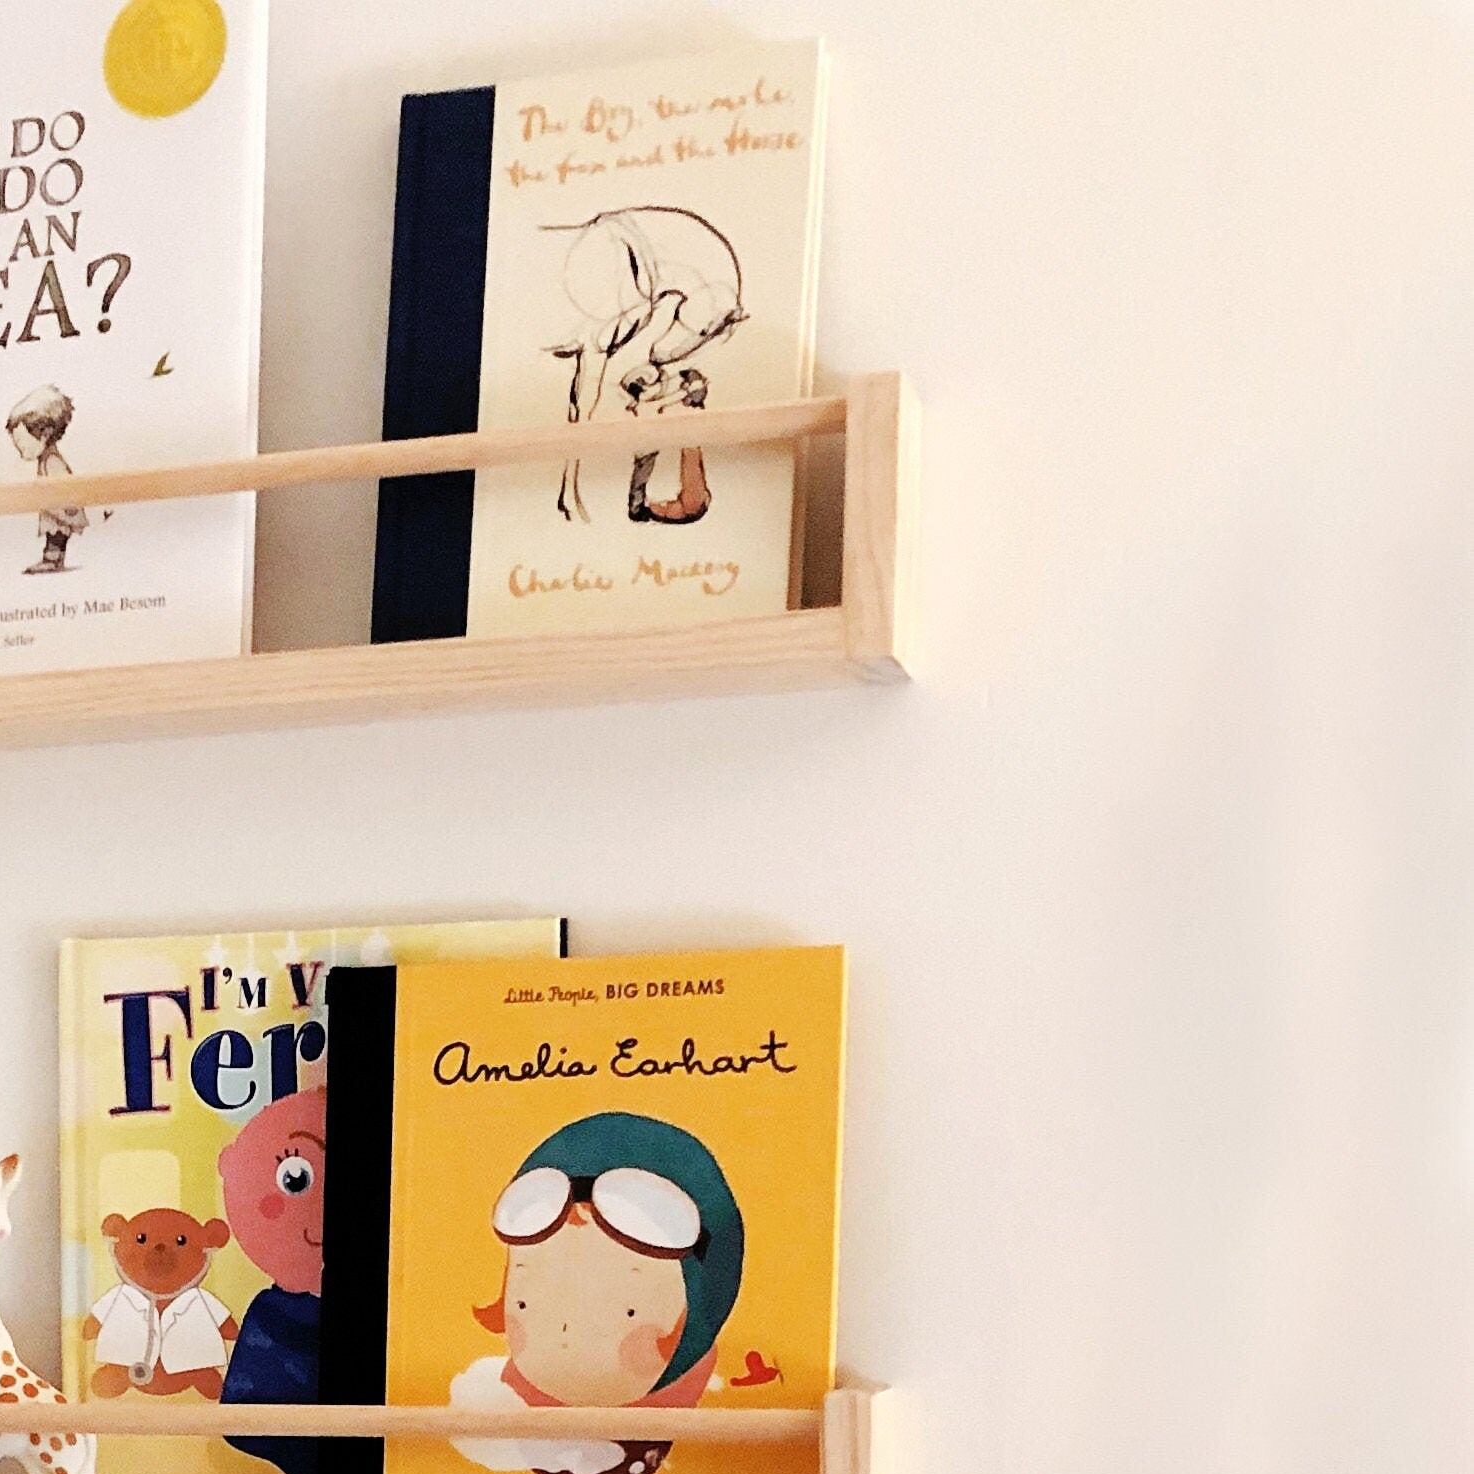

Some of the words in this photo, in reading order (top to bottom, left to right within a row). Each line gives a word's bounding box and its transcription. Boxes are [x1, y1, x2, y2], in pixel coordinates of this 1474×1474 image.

[10, 110, 86, 159] DO
[519, 103, 568, 141] The
[504, 157, 548, 188] the
[673, 134, 718, 162] the
[8, 211, 81, 263] AN
[61, 601, 78, 619] by
[83, 600, 115, 615] Mae
[504, 987, 545, 1004] Little
[548, 986, 599, 1006] People,
[606, 983, 638, 999] BIG
[646, 979, 725, 998] DREAMS
[433, 1041, 598, 1086] Amelia
[609, 1030, 797, 1078] Earhart
